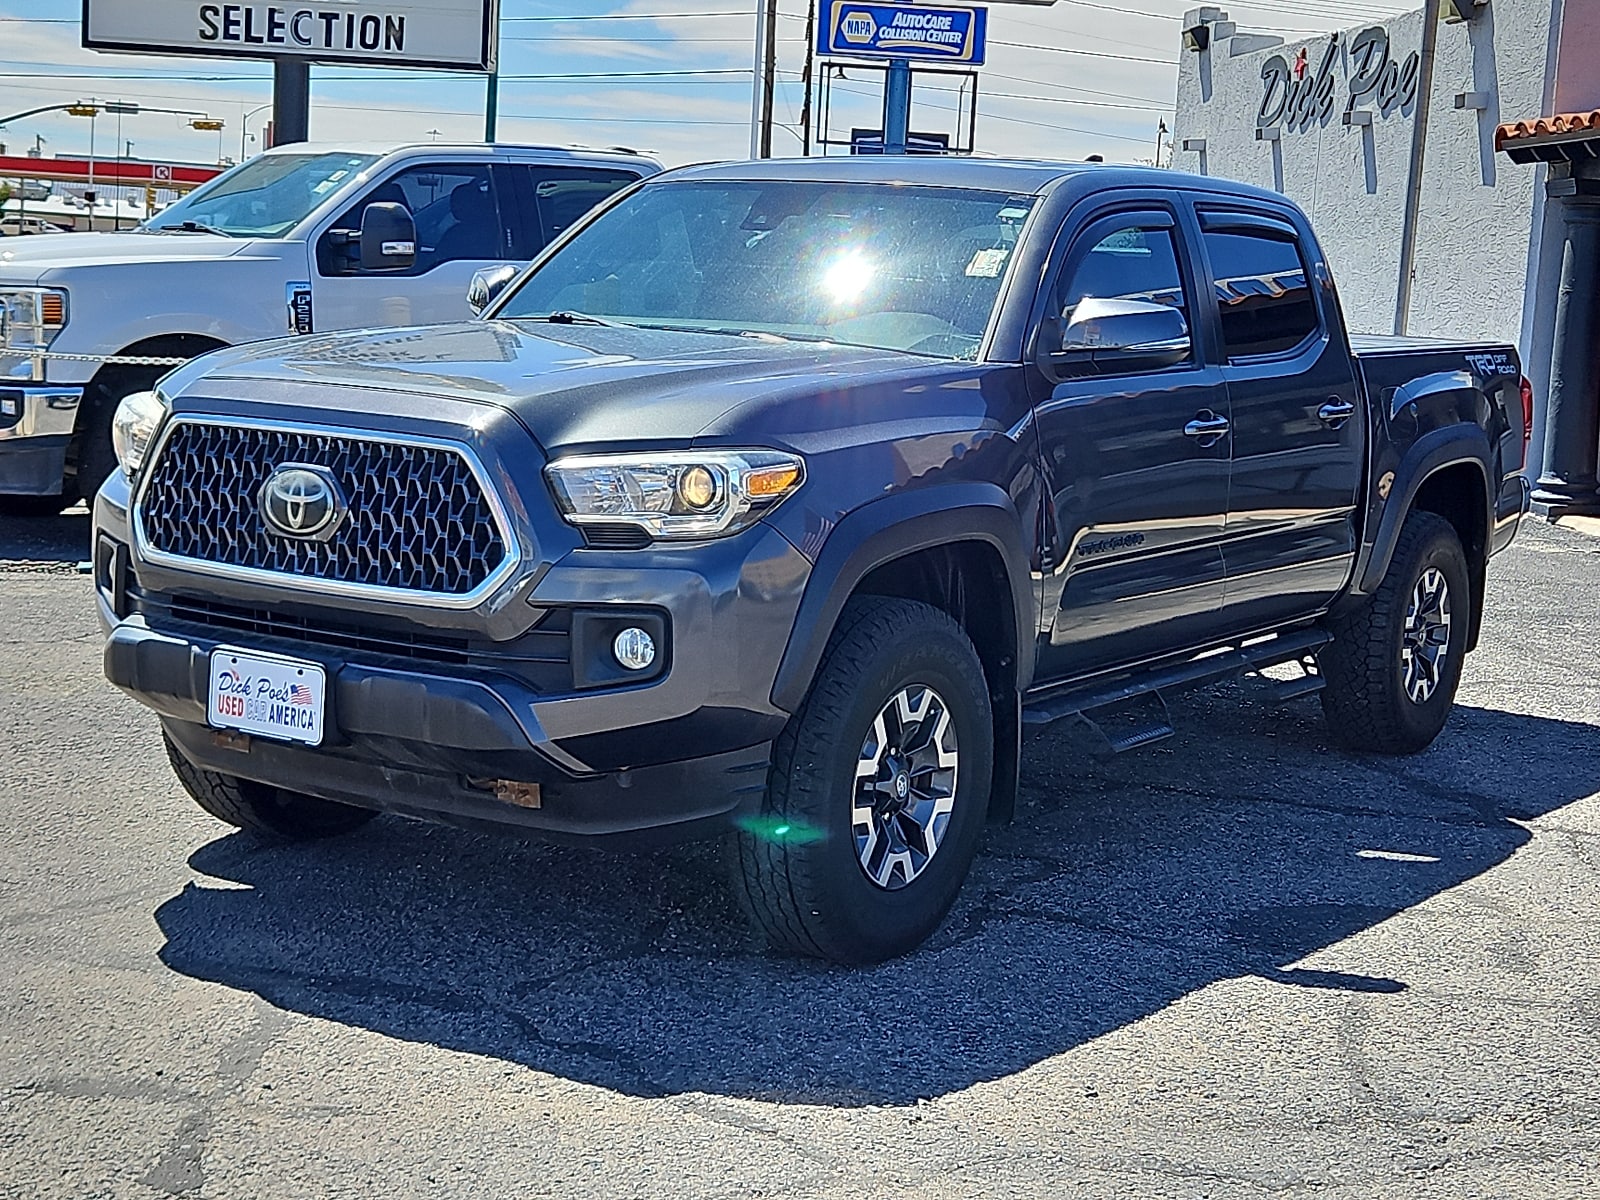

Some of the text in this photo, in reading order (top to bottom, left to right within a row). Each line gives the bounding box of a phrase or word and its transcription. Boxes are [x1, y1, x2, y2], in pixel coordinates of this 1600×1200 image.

[199, 5, 405, 51] SELECTION
[846, 20, 872, 36] NAPA
[878, 26, 963, 44] COLLISION CENTER
[1257, 25, 1420, 128] Dick Poe
[1465, 354, 1496, 375] TRD
[1494, 354, 1507, 363] OFF
[218, 672, 290, 703] Dick Poe's
[218, 694, 244, 717] USED
[268, 703, 314, 731] AMERICA
